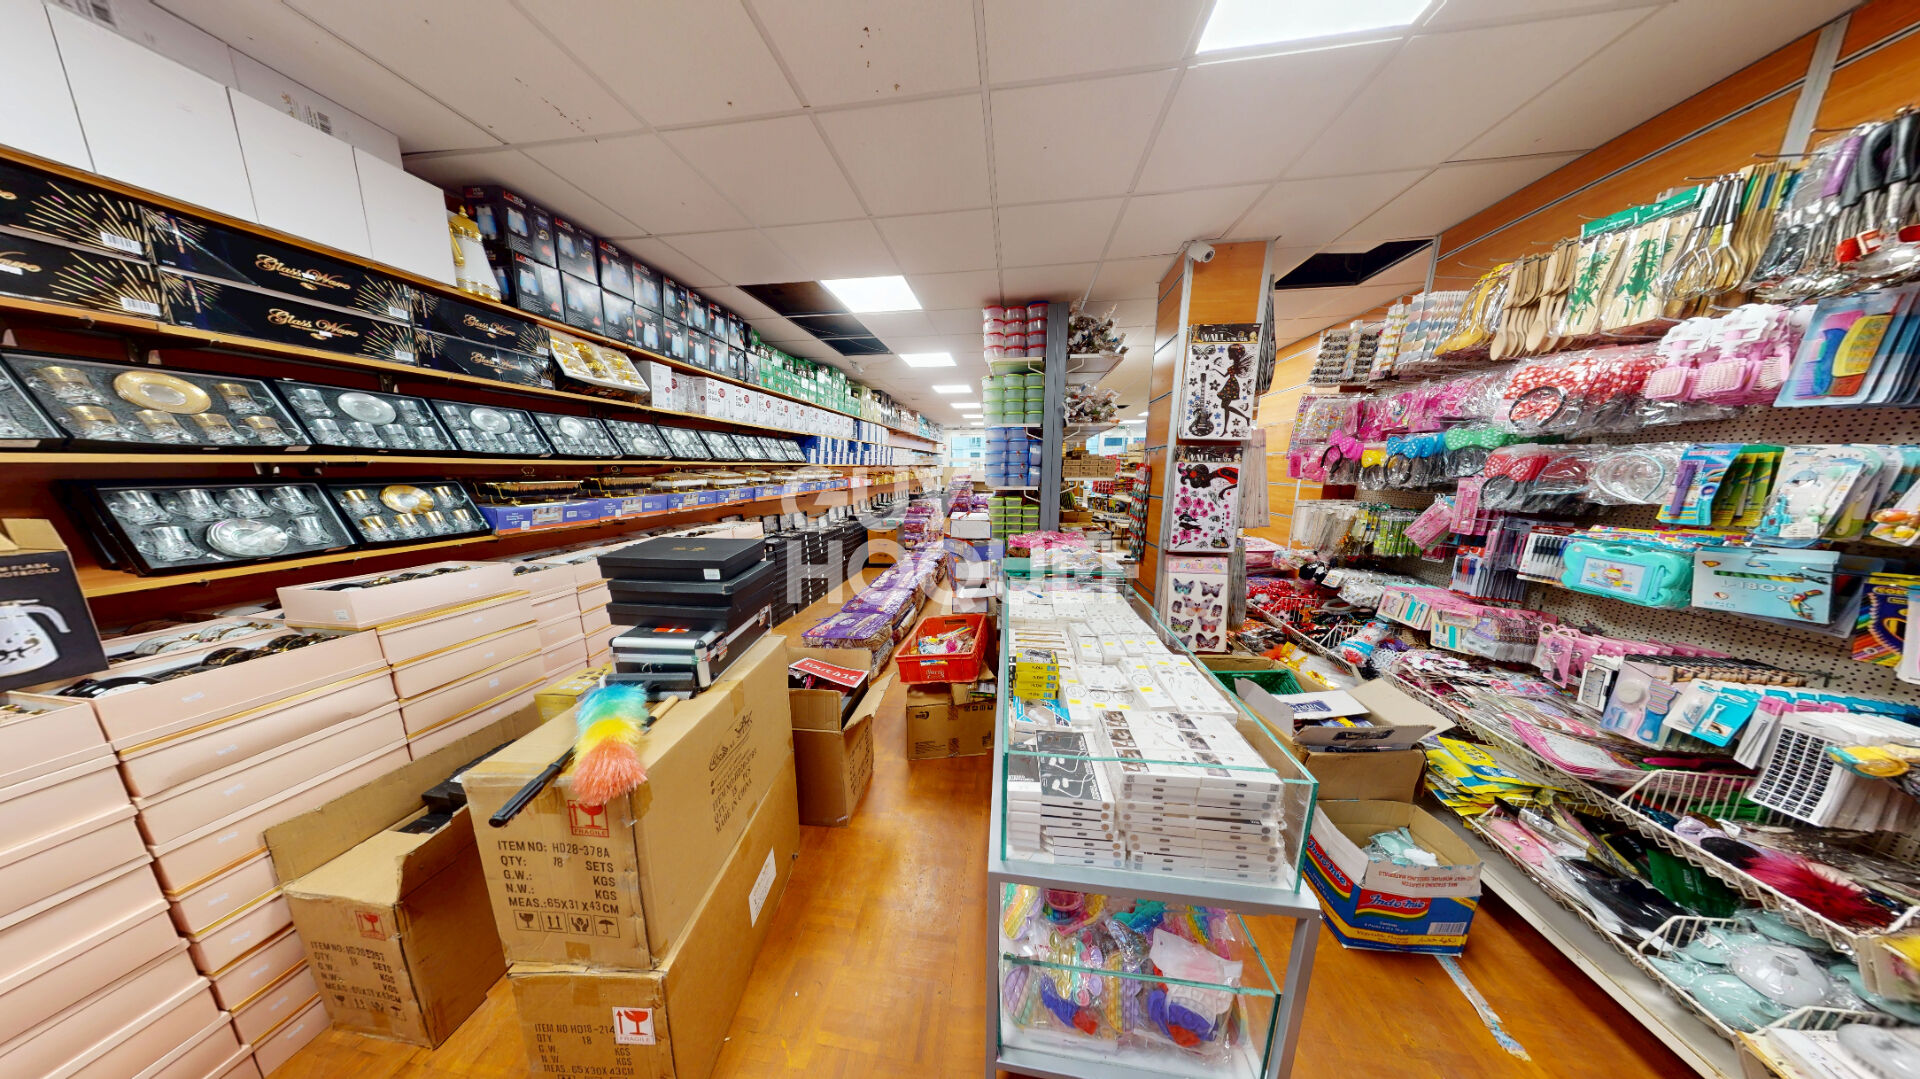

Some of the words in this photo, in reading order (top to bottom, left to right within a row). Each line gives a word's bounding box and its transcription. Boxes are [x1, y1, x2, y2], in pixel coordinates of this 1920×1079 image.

[255, 254, 302, 278] Glass
[304, 269, 352, 290] Ware
[267, 308, 313, 328] Glass
[315, 319, 359, 337] Ware
[497, 840, 526, 852] ITEM
[528, 841, 548, 853] NO:
[552, 842, 611, 859] HD28-378A
[500, 855, 527, 867] QTY:
[585, 860, 614, 873] SETS
[592, 875, 616, 888] KGS
[594, 889, 618, 901] KGS
[310, 940, 331, 950] ITEM
[534, 1023, 554, 1034] ITEM
[614, 1047, 632, 1057] KGS
[615, 1057, 633, 1067] KGS
